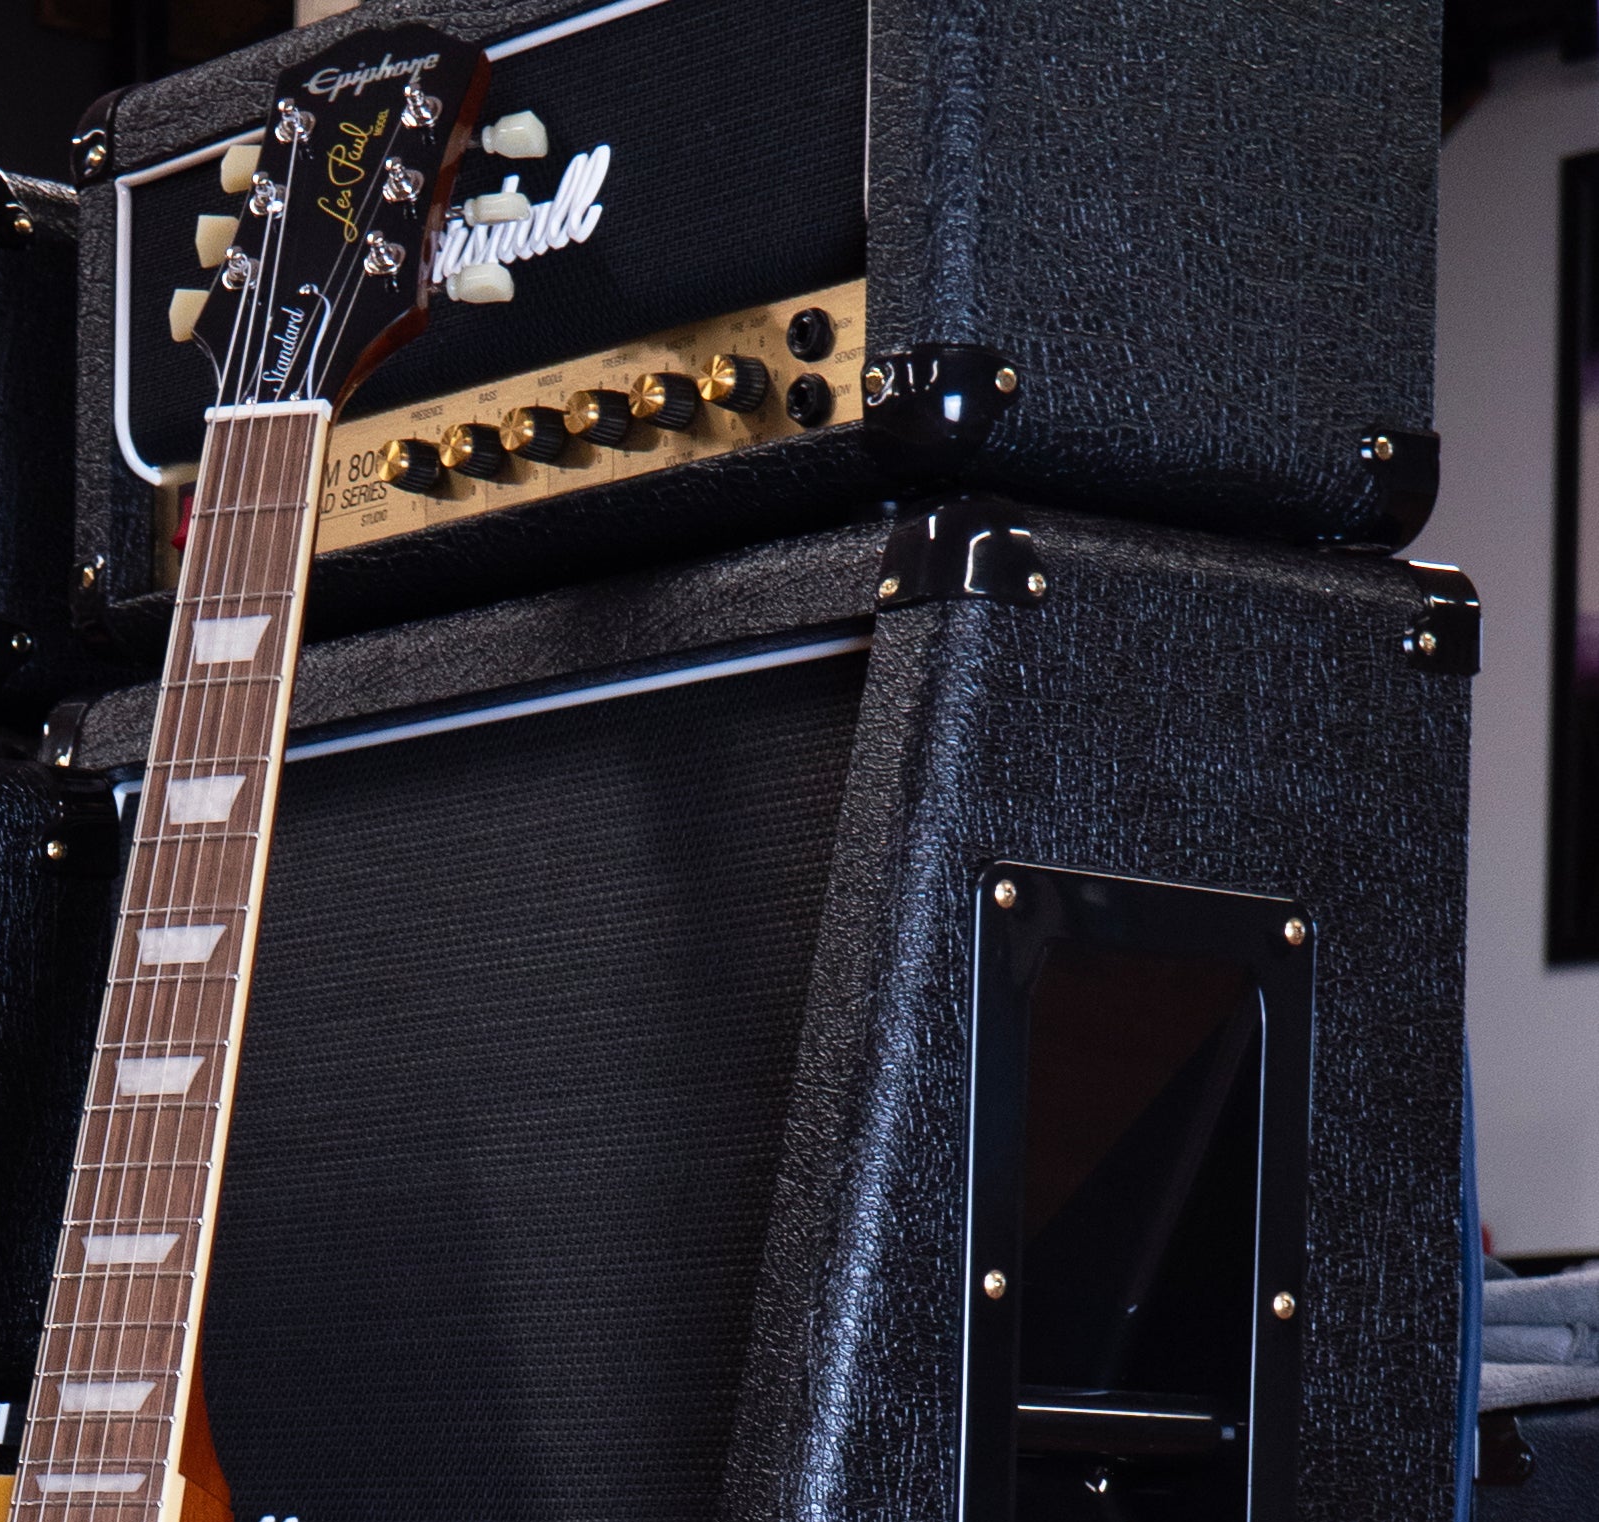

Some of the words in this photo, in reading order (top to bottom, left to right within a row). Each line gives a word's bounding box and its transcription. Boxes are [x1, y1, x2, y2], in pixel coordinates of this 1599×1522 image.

[302, 53, 441, 103] Epiphone
[327, 122, 375, 186] Paul
[317, 188, 359, 243] Les
[262, 306, 306, 394] Standard
[478, 389, 498, 404] BASS
[347, 449, 380, 485] 80
[340, 480, 389, 510] SERIES
[360, 508, 389, 527] STUDIO
